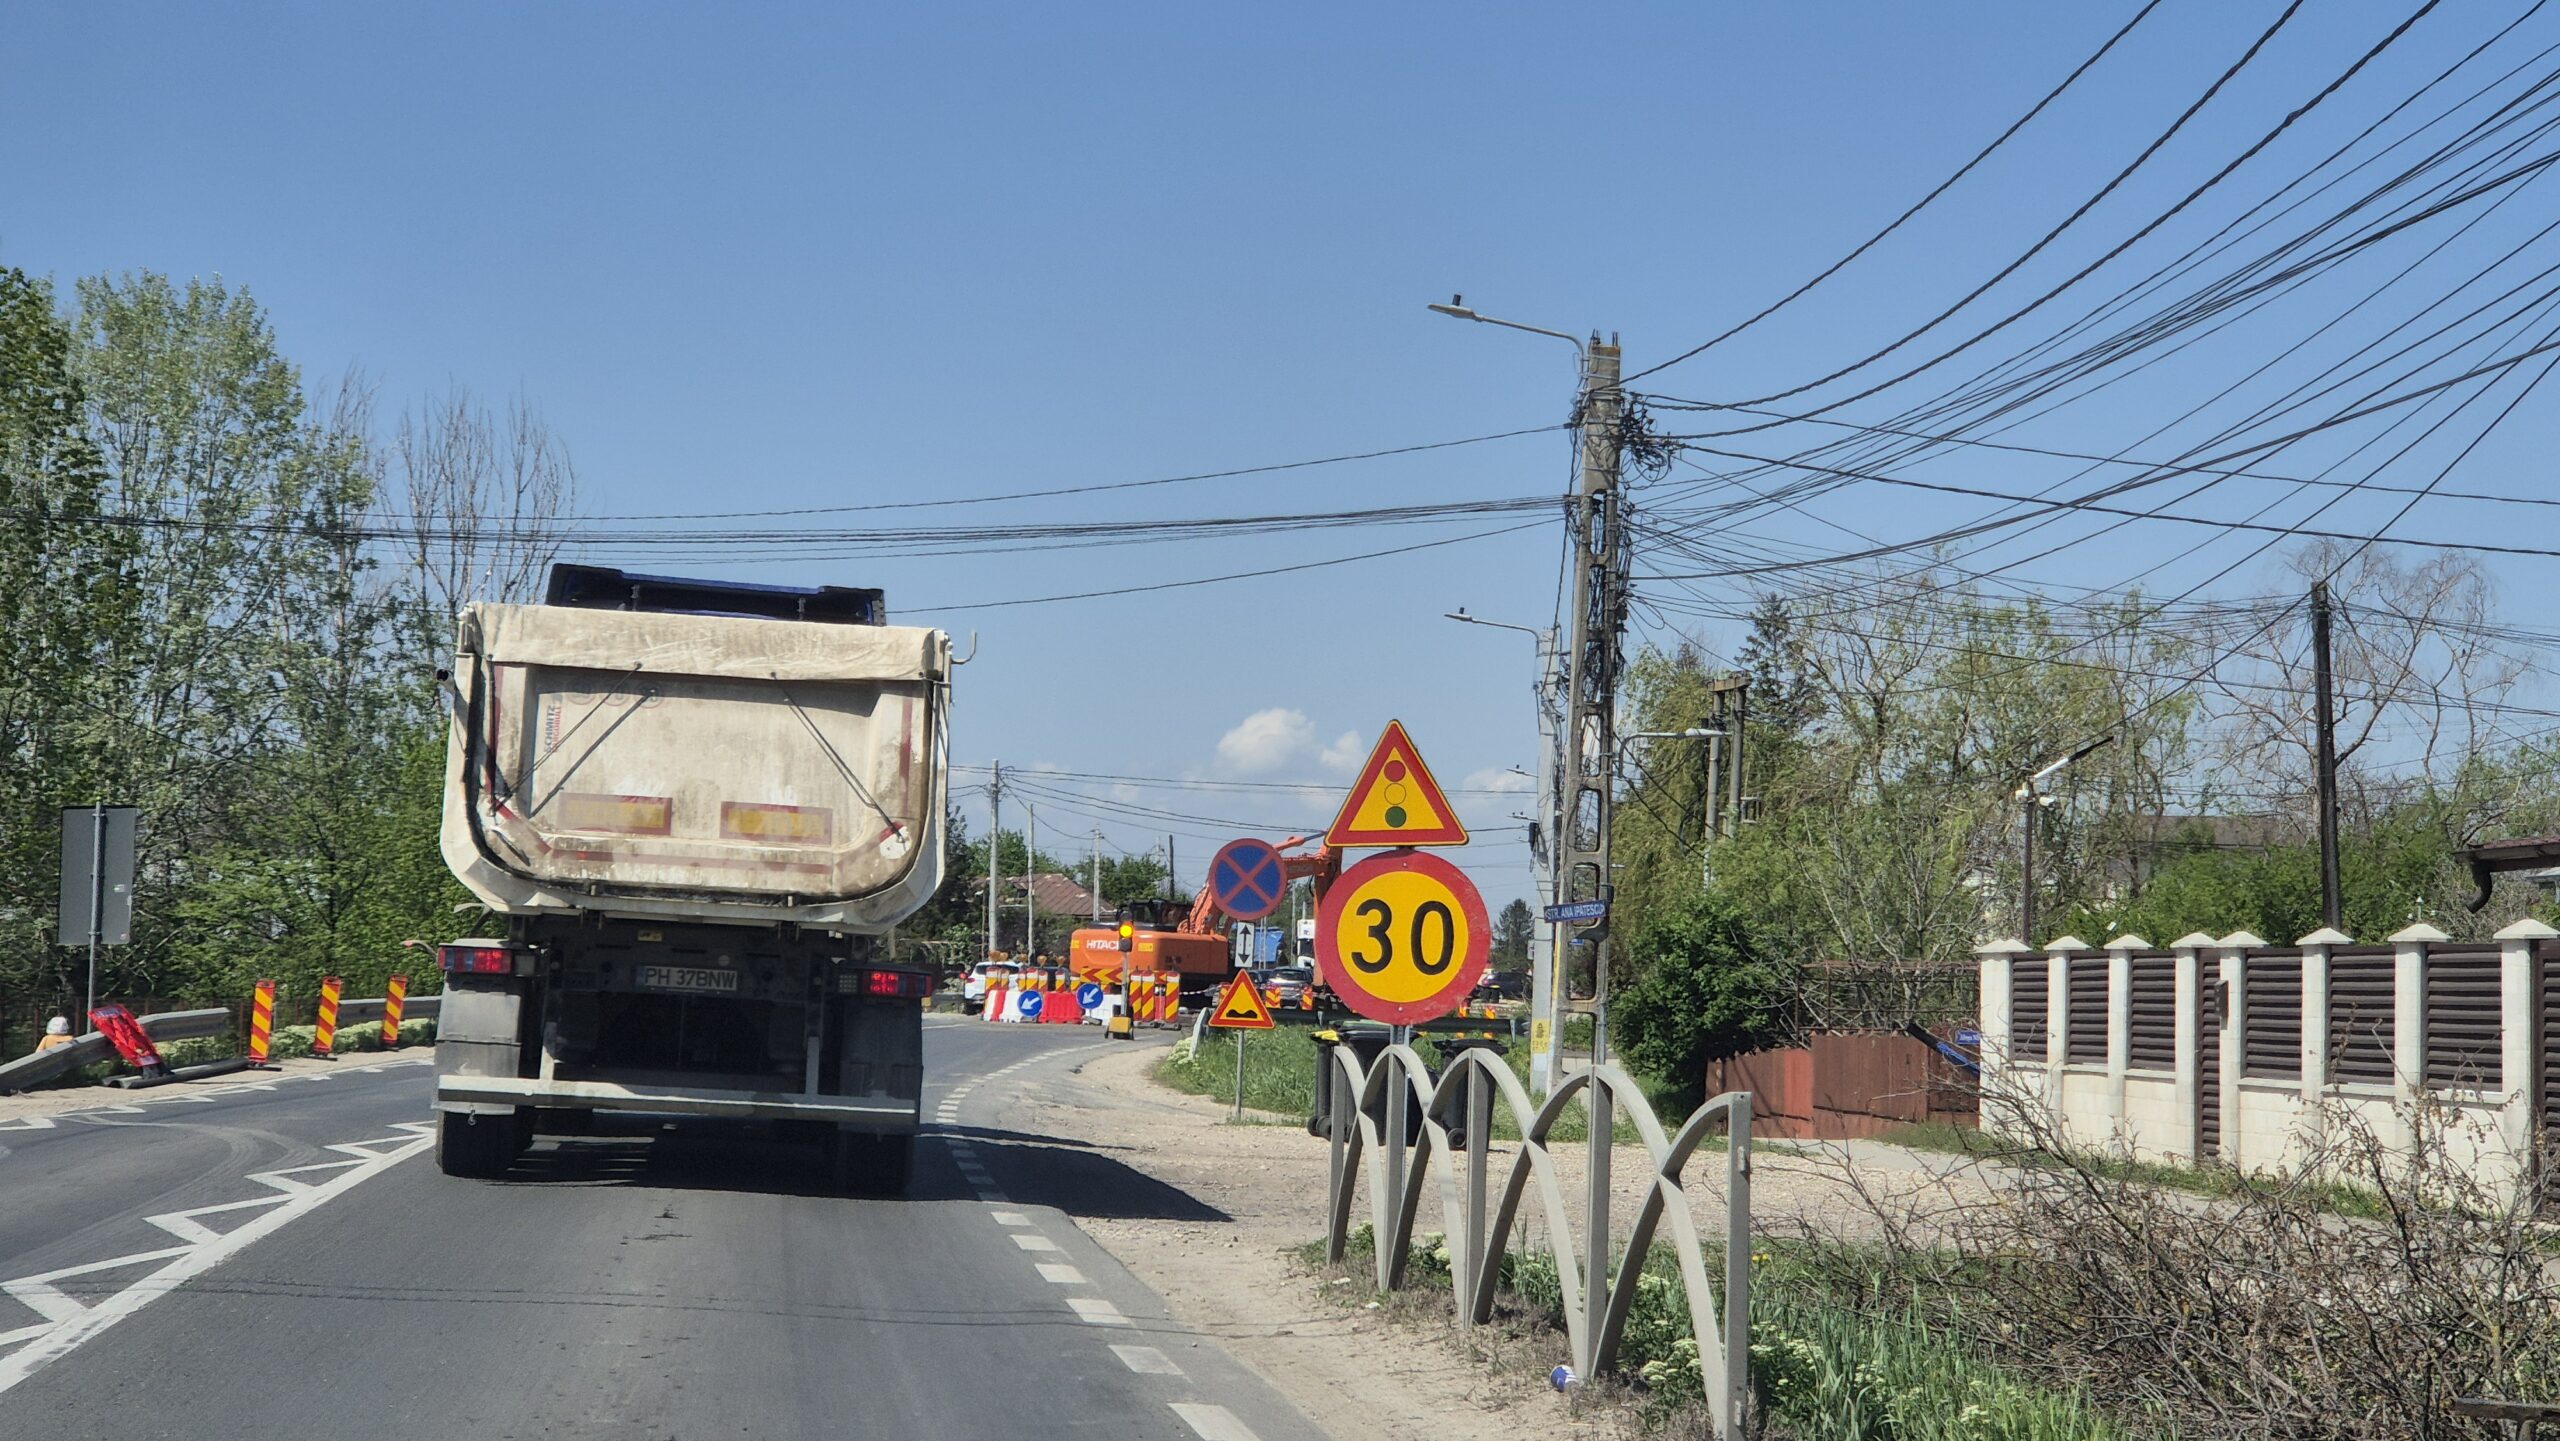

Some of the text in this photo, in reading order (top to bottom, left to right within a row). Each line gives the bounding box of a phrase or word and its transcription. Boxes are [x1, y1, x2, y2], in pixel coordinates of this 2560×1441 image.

[544, 704, 555, 753] SCHMITZ
[1561, 906, 1574, 918] ANA
[1351, 898, 1455, 976] 30
[645, 967, 735, 989] PH 37BNW
